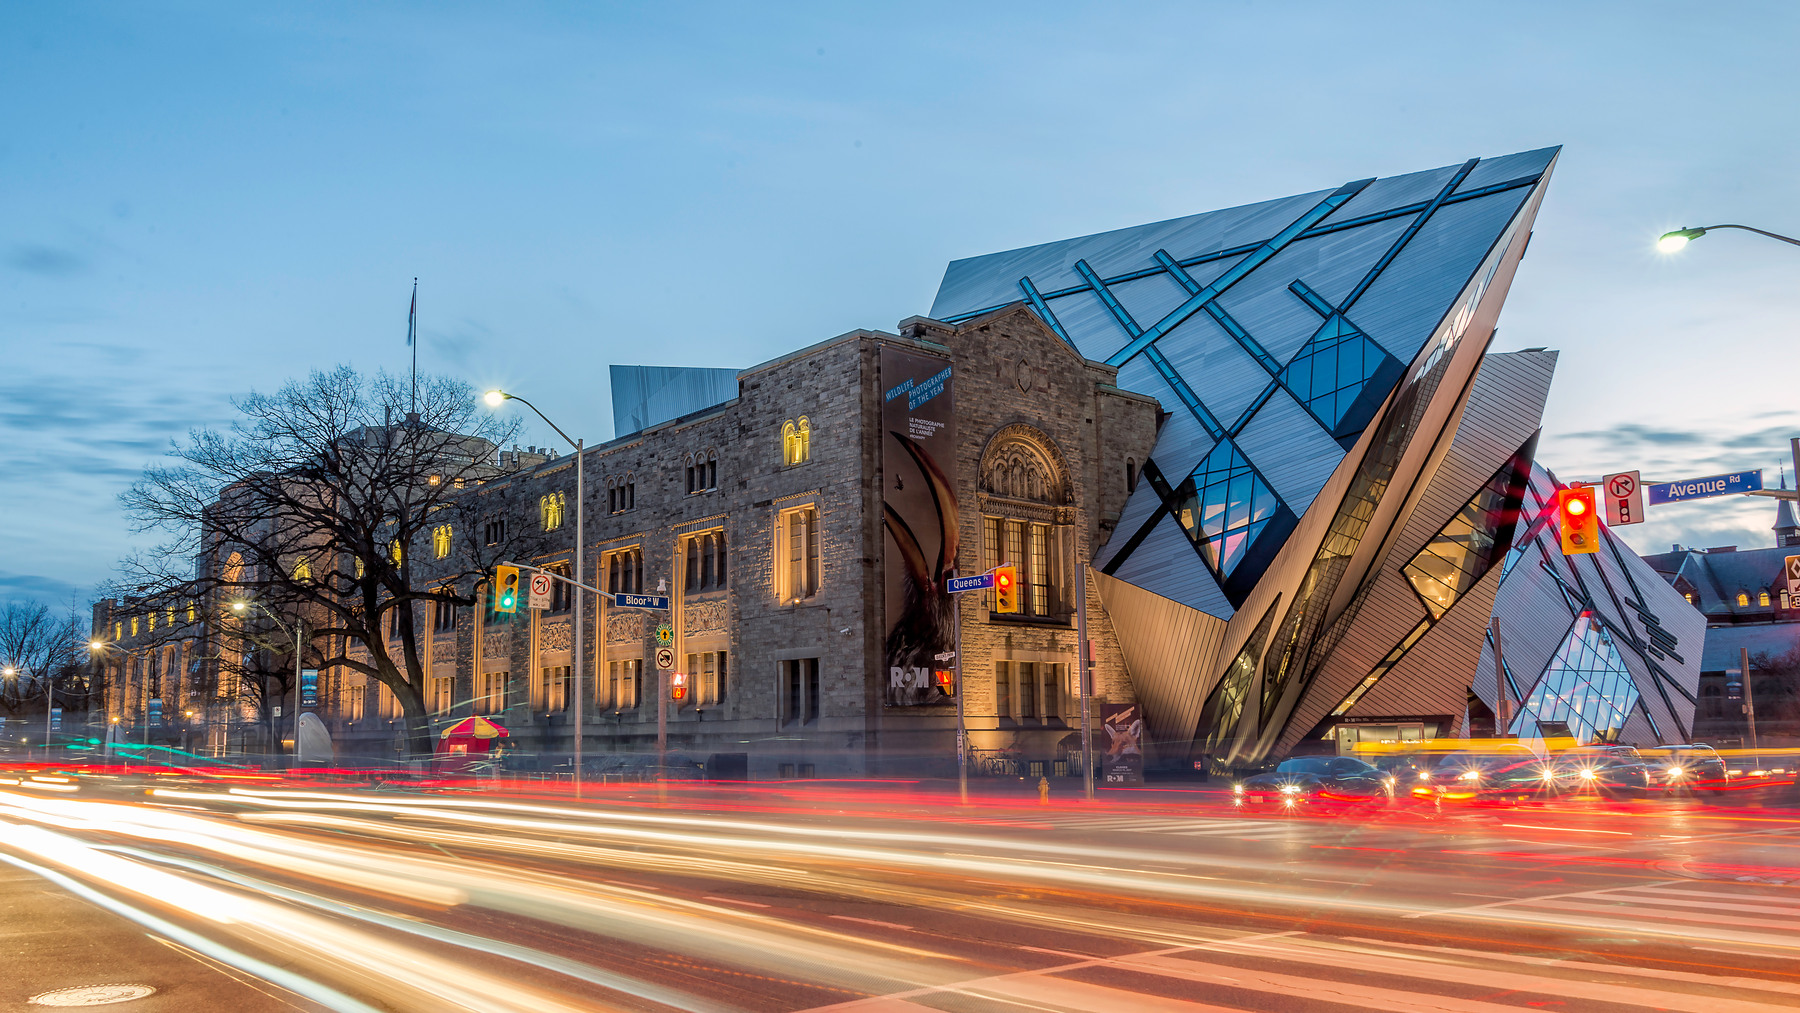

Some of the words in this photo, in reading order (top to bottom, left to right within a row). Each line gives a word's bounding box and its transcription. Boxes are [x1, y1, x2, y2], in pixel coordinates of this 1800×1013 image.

[886, 379, 914, 400] WILDLIFE
[909, 368, 952, 398] PHOTOGRAPHER
[909, 400, 916, 409] OF
[918, 393, 929, 404] THE
[930, 383, 944, 397] YEAR
[915, 418, 944, 428] PHOTOGRAPHE
[1668, 480, 1726, 498] Avenue
[1729, 475, 1741, 483] Rd
[953, 579, 982, 589] Queens
[626, 595, 647, 605] Bloor
[652, 597, 660, 606] W
